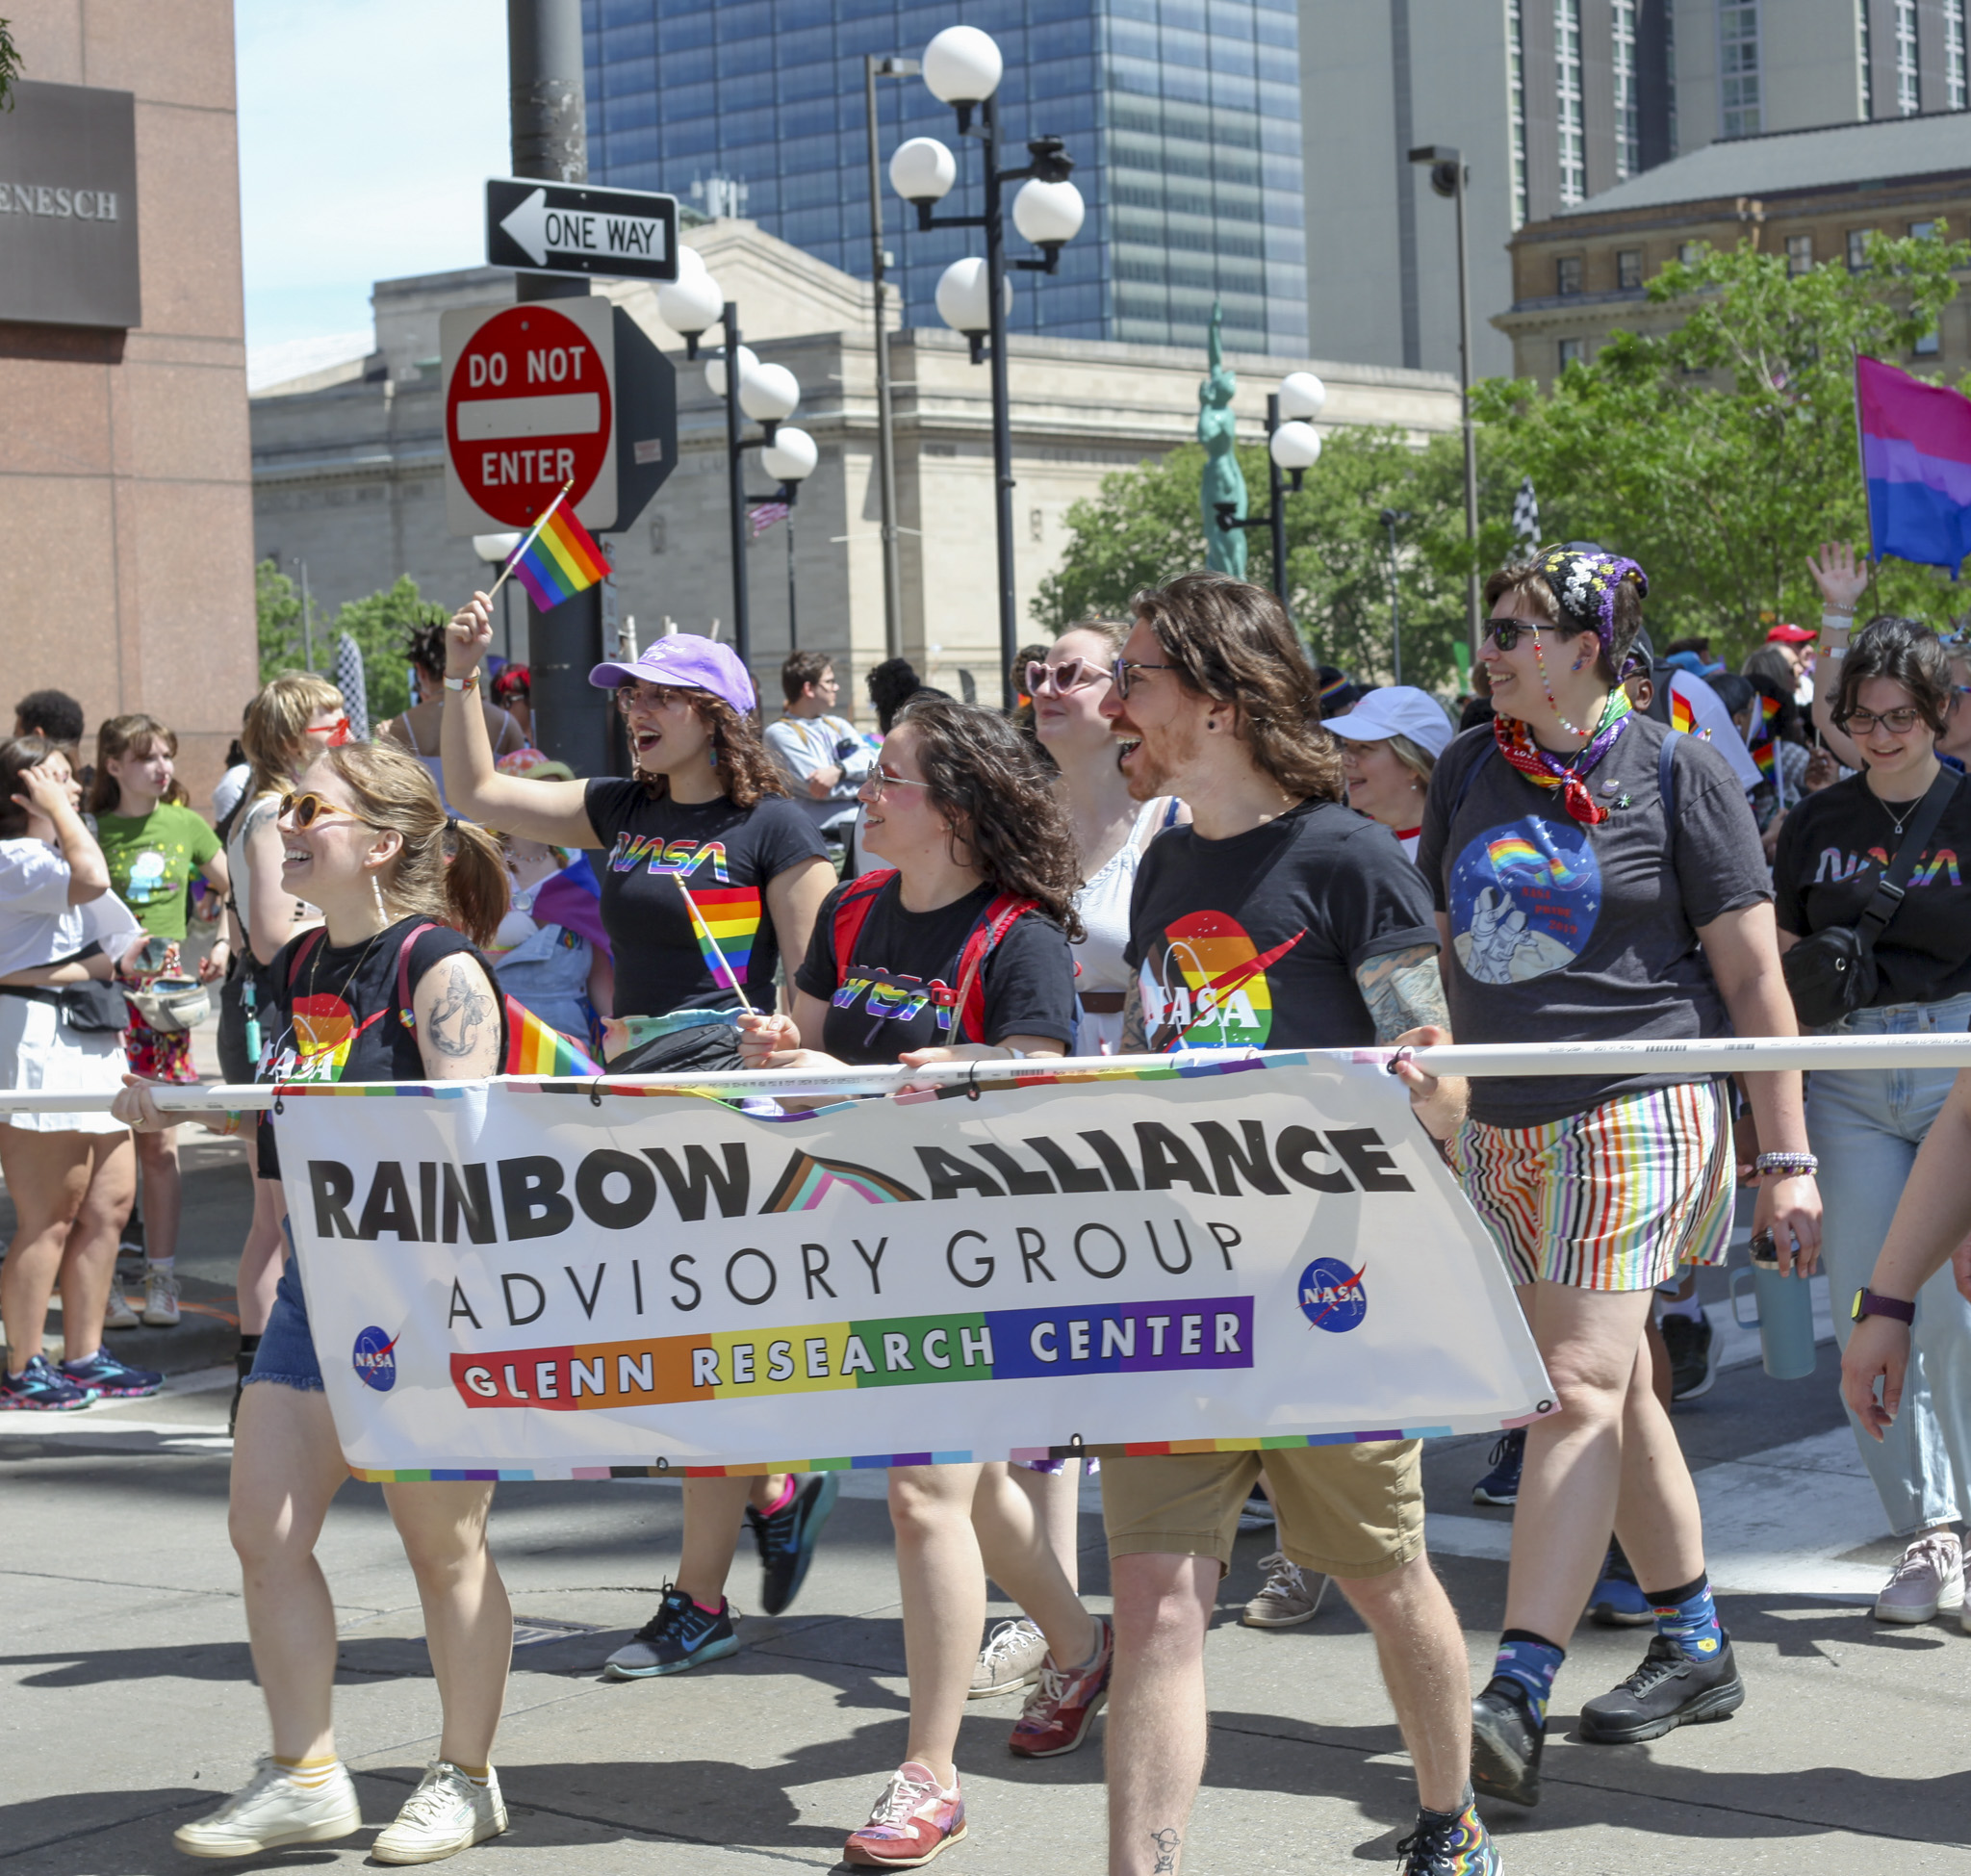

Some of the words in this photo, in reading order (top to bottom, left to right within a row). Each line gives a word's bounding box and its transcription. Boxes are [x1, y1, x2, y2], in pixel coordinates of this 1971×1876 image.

[0, 183, 118, 221] ENESCH
[546, 215, 597, 248] ONE
[606, 221, 657, 254] WAY
[469, 352, 508, 388] DO
[527, 347, 586, 383] NOT
[481, 449, 576, 486] ENTER
[606, 832, 730, 883] NASA
[1521, 886, 1551, 900] NASA
[1534, 904, 1573, 918] PRIDE
[1548, 919, 1578, 935] 2019
[1143, 986, 1262, 1028] NASA
[308, 1143, 749, 1244] RAINBOW
[913, 1119, 1414, 1201] ALLIANCE
[448, 1237, 887, 1329] ADVISORY
[946, 1219, 1241, 1288] GROUP
[1303, 1286, 1366, 1304] NASA
[355, 1352, 395, 1368] NASA
[464, 1352, 653, 1400] GLENN
[692, 1326, 995, 1387] RESEARCH
[1030, 1312, 1241, 1363] CENTER
